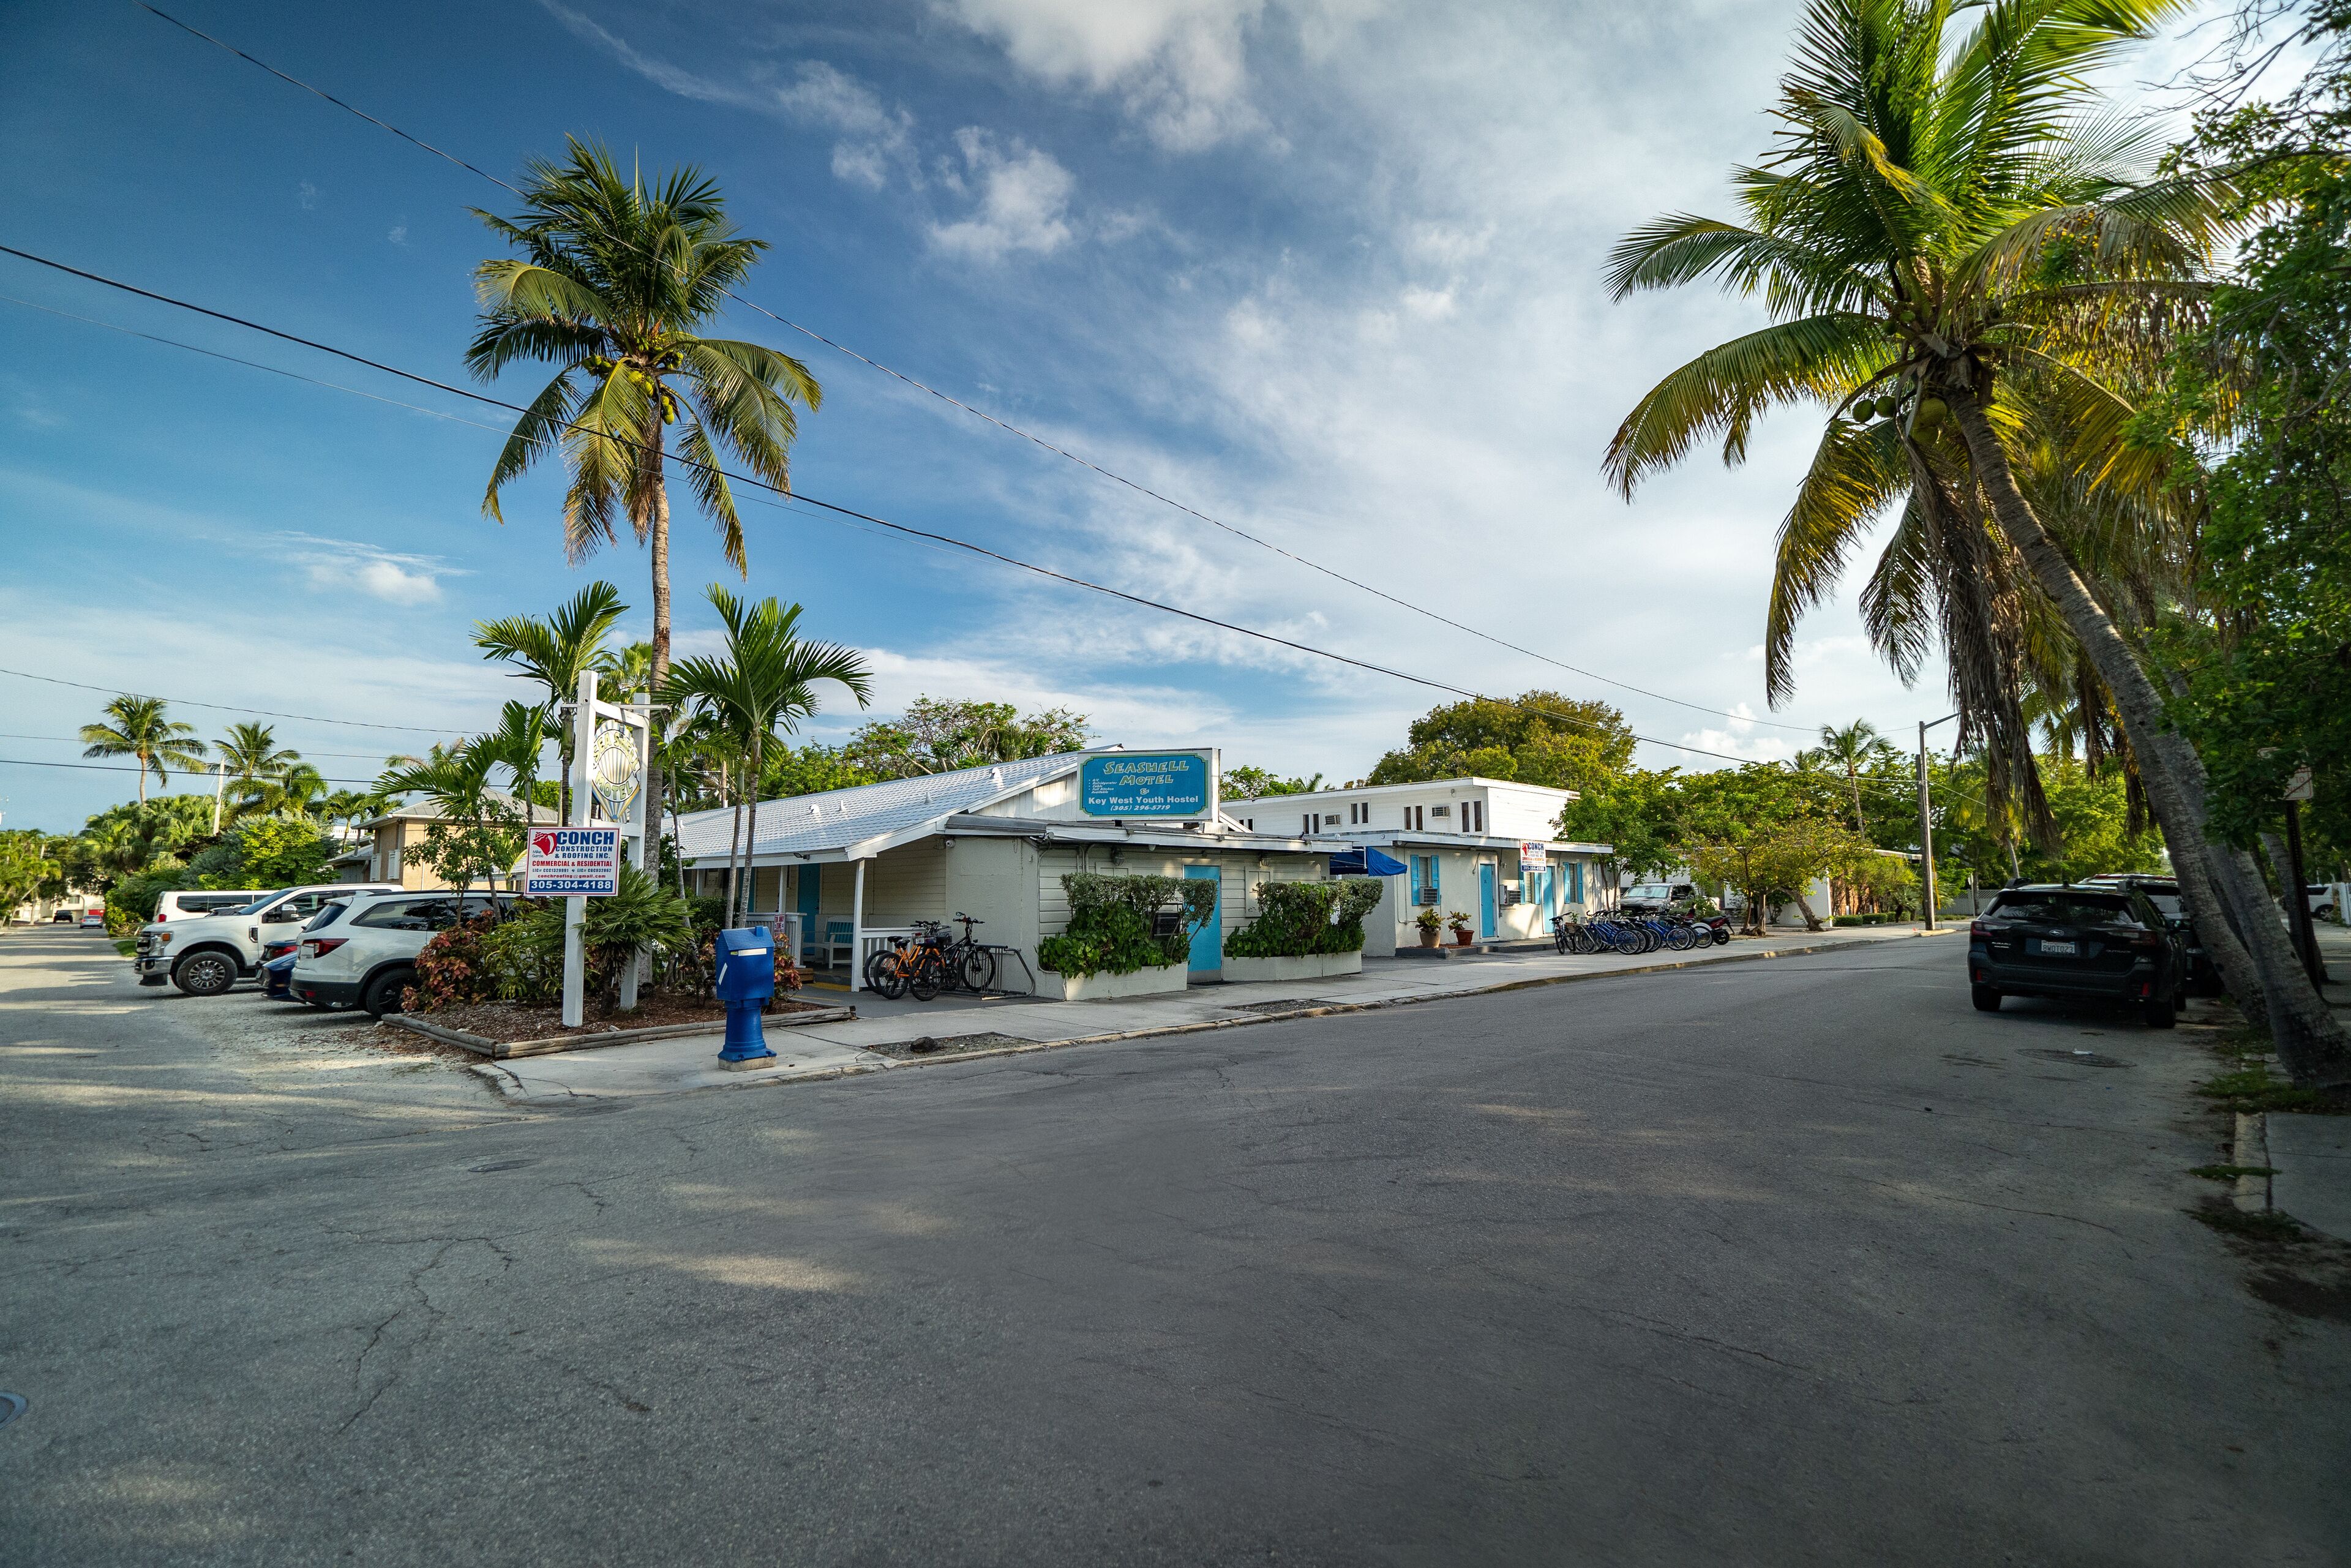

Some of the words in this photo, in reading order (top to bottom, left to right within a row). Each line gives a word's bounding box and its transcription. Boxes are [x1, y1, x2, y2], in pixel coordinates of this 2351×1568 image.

[594, 732, 612, 762] SEA
[1103, 760, 1190, 775] SEASHELL
[595, 771, 633, 800] MOTEL
[1119, 775, 1174, 786] MOTEL
[557, 831, 614, 845] CONCH
[531, 880, 611, 889] 305-304-4188
